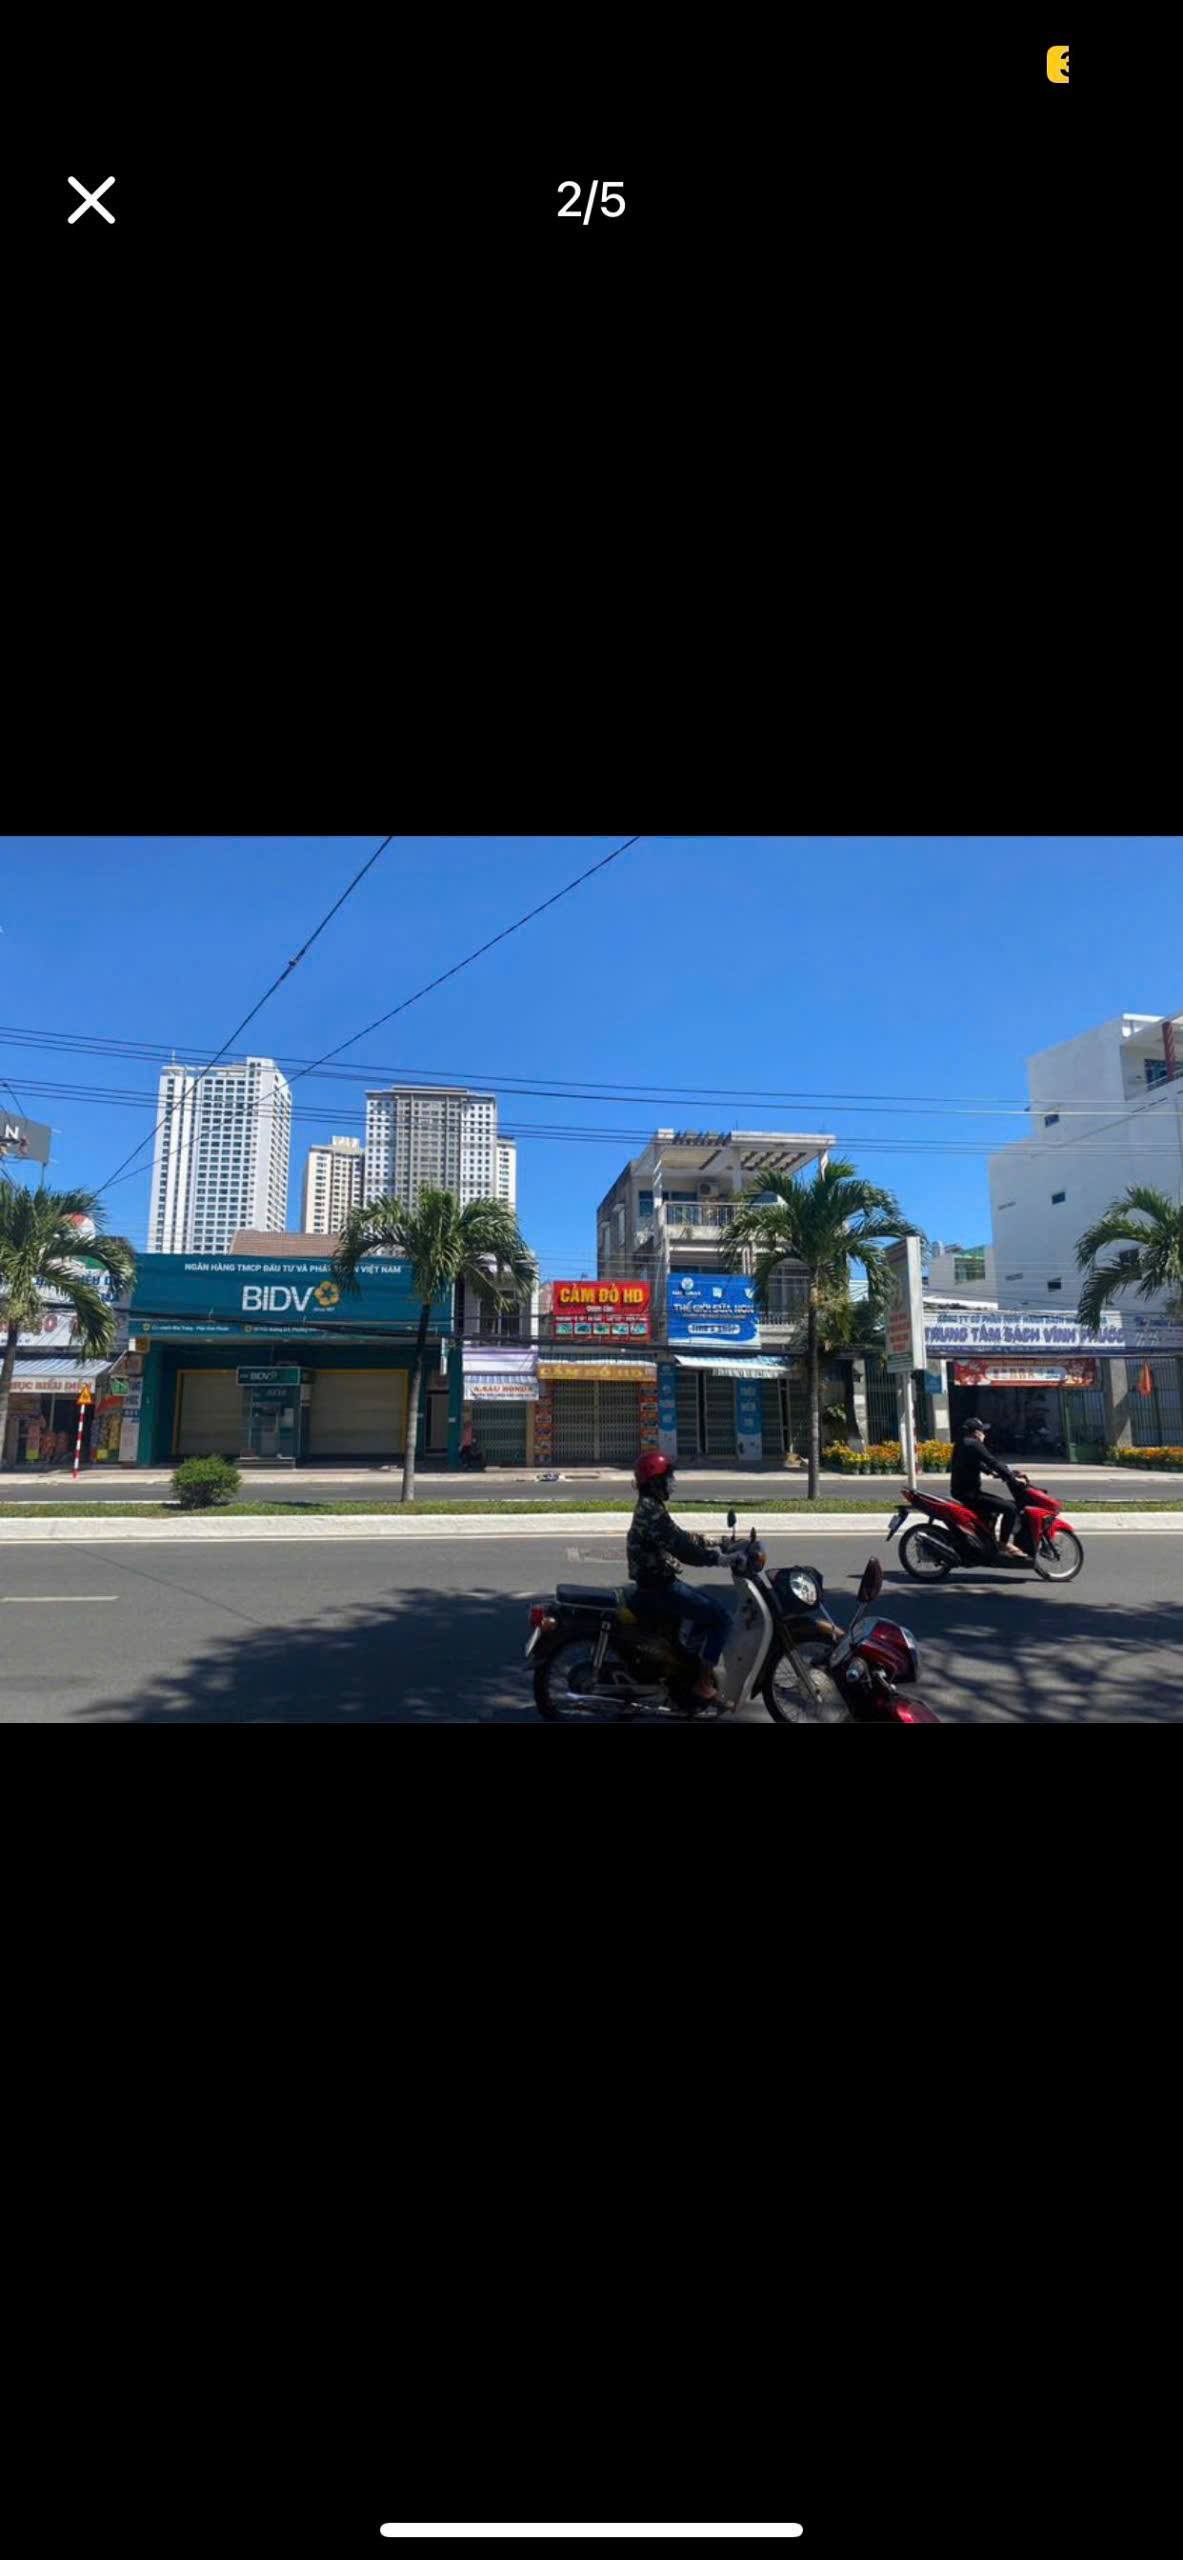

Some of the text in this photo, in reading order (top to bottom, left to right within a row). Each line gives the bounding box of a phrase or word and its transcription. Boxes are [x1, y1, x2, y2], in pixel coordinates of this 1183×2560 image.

[184, 1262, 209, 1272] NGÂN
[210, 1262, 235, 1272] HÀNG
[237, 1263, 262, 1273] TMCP
[360, 1264, 379, 1275] VIỆT
[380, 1264, 402, 1274] NAM
[241, 1285, 315, 1312] BIDV
[623, 1287, 643, 1303] HD
[925, 1326, 968, 1342] TRUNG
[970, 1323, 1001, 1343] TÂM
